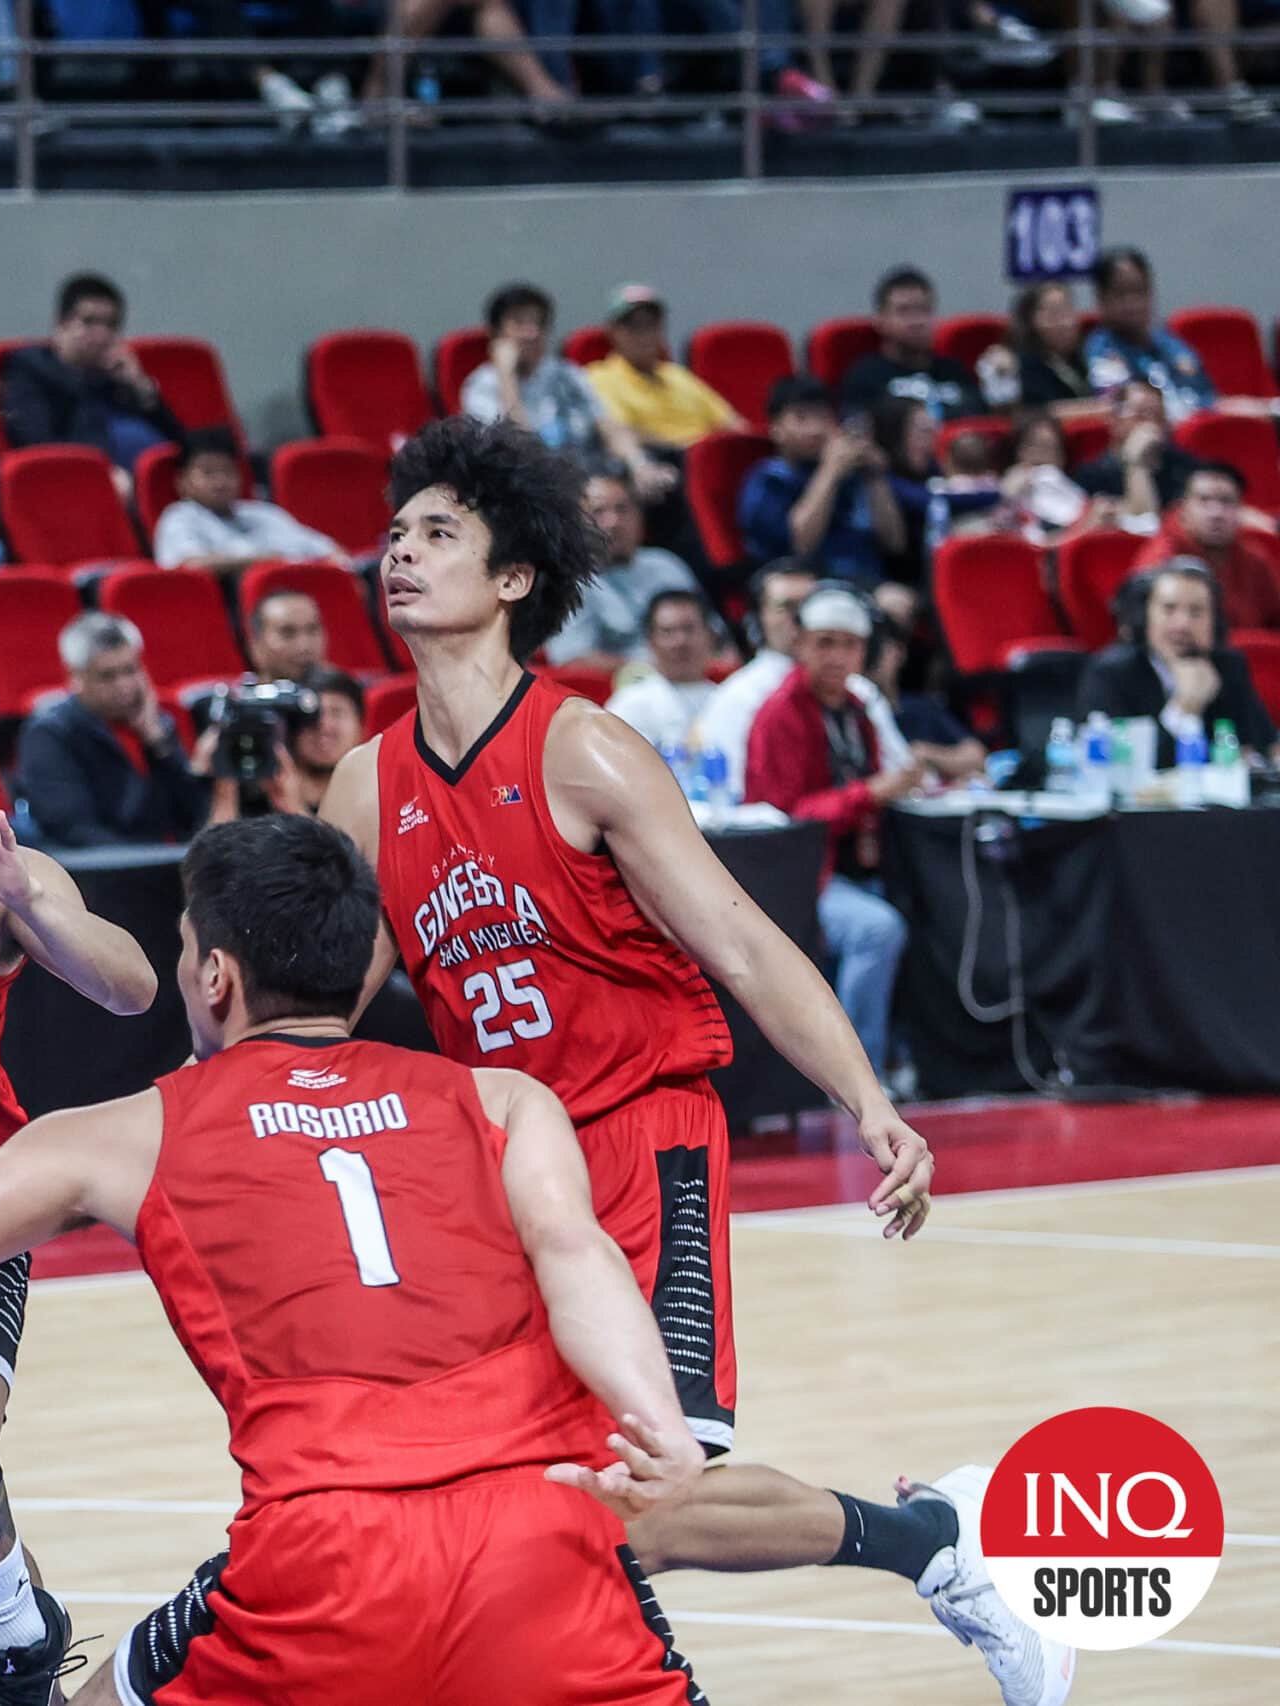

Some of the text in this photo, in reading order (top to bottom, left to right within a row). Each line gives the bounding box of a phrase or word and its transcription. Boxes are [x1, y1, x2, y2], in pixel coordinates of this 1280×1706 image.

[1013, 197, 1094, 271] 103
[438, 919, 552, 968] SAN MIGUE
[463, 958, 553, 1054] 25
[248, 1092, 409, 1139] ROSARIO
[317, 1146, 401, 1287] 1
